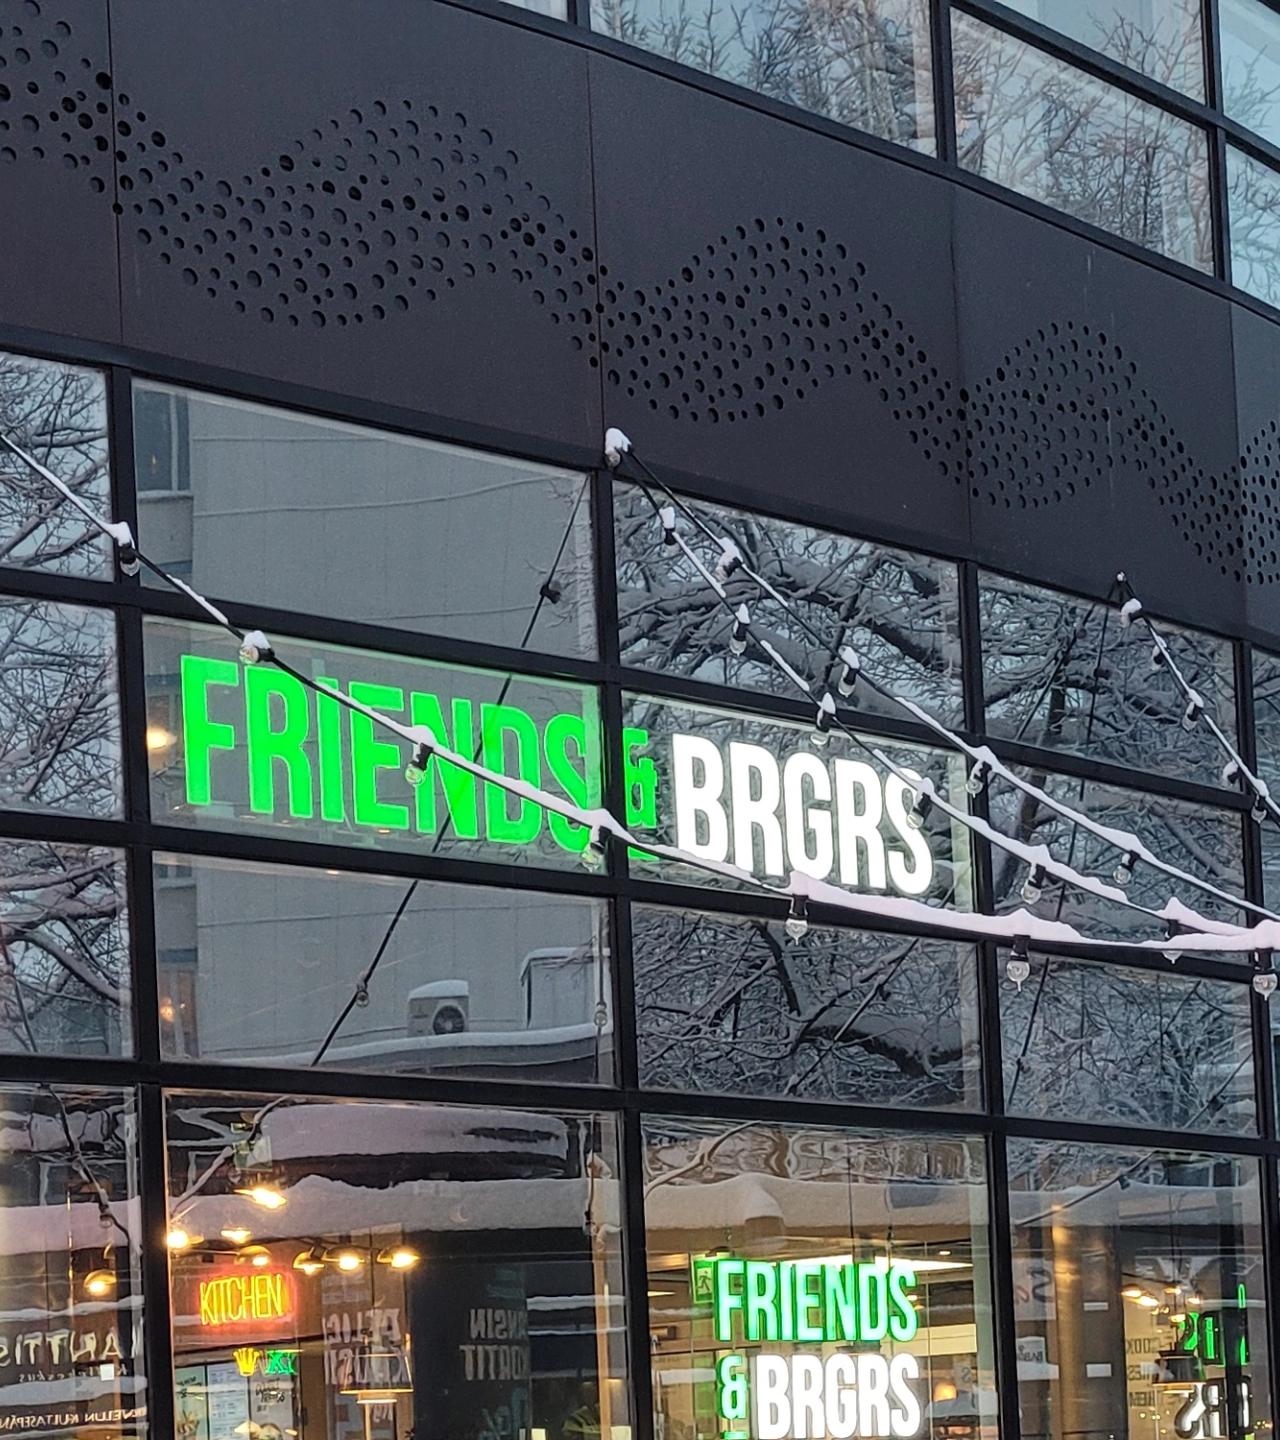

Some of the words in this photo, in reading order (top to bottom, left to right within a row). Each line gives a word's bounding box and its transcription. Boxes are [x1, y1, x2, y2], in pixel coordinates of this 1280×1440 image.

[180, 654, 594, 856] FRIENDS
[672, 733, 935, 895] BRGRS
[200, 1273, 285, 1326] KITCHEN
[713, 1257, 919, 1342] FRIENDS
[717, 1353, 751, 1440] &
[756, 1353, 921, 1440] BRGRS
